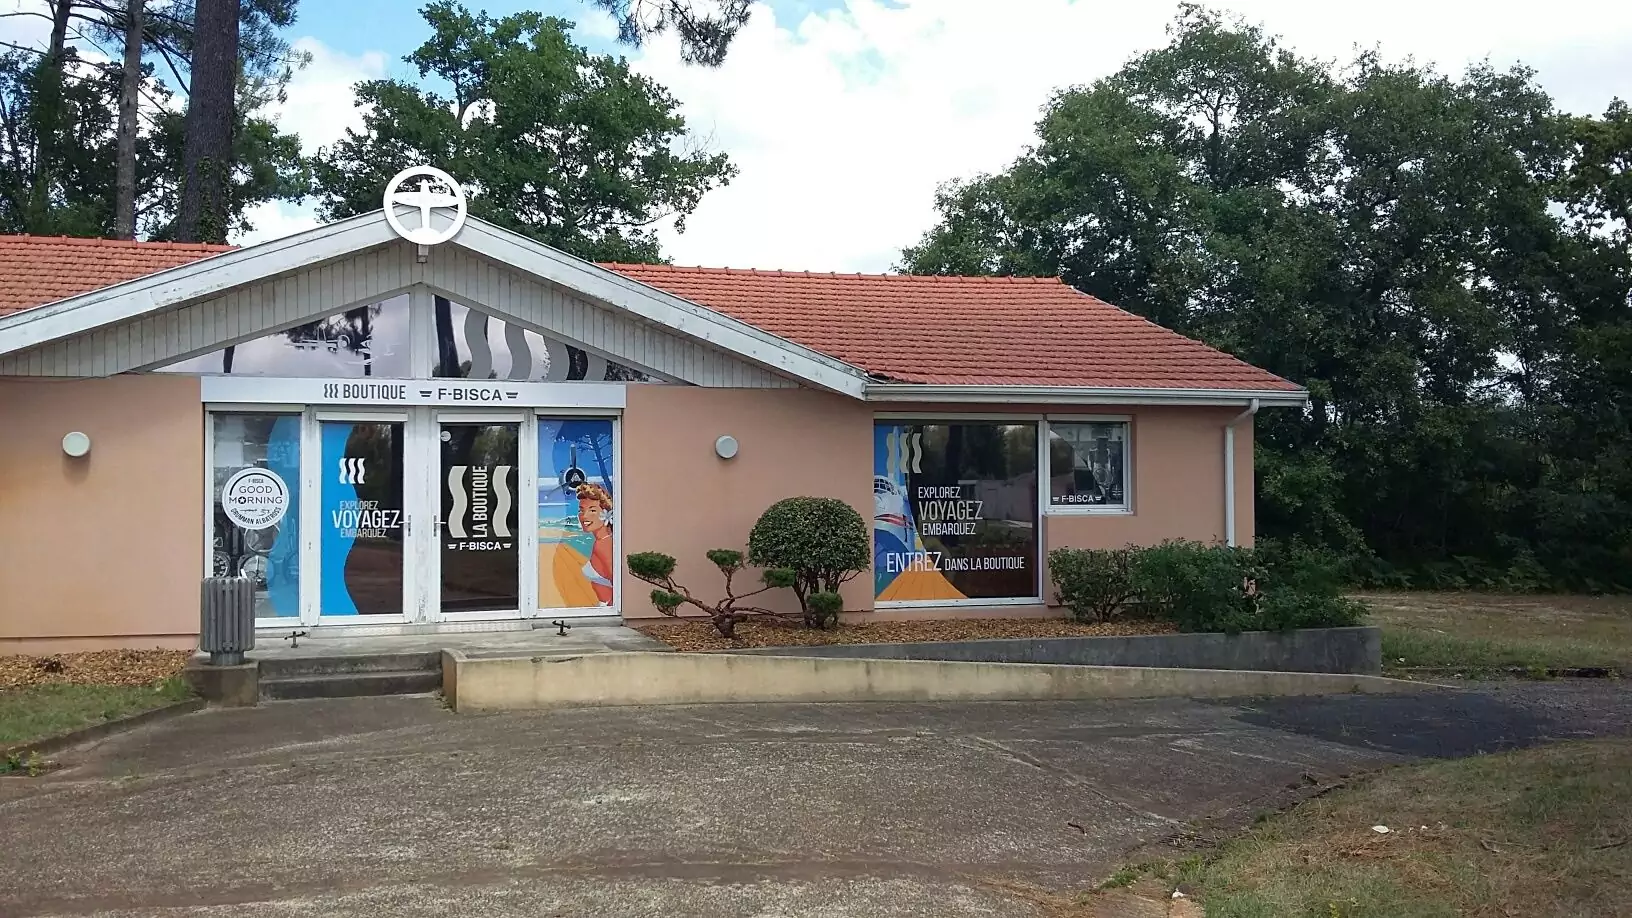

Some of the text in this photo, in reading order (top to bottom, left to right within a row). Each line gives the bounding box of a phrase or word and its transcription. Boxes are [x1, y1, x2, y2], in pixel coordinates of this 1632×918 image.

[343, 384, 406, 400] BOUTIQUE
[438, 388, 502, 401] F-BISCA
[239, 485, 272, 494] GOOD
[918, 486, 961, 499] EXPLOREZ
[228, 496, 283, 505] MORNING
[340, 500, 379, 510] EXPLOREZ
[472, 465, 488, 538] LA BOUTIQUE
[1061, 494, 1094, 503] F-BISCA
[918, 500, 983, 521] VOYAGEZ
[332, 510, 400, 529] VOYAGEZ
[340, 528, 387, 538] EMBARQUEZ
[922, 522, 976, 536] EMBARQUEZ
[459, 541, 502, 551] F-BISCA
[886, 551, 1025, 573] ENTREZ DANS LA BOUTIQUE
